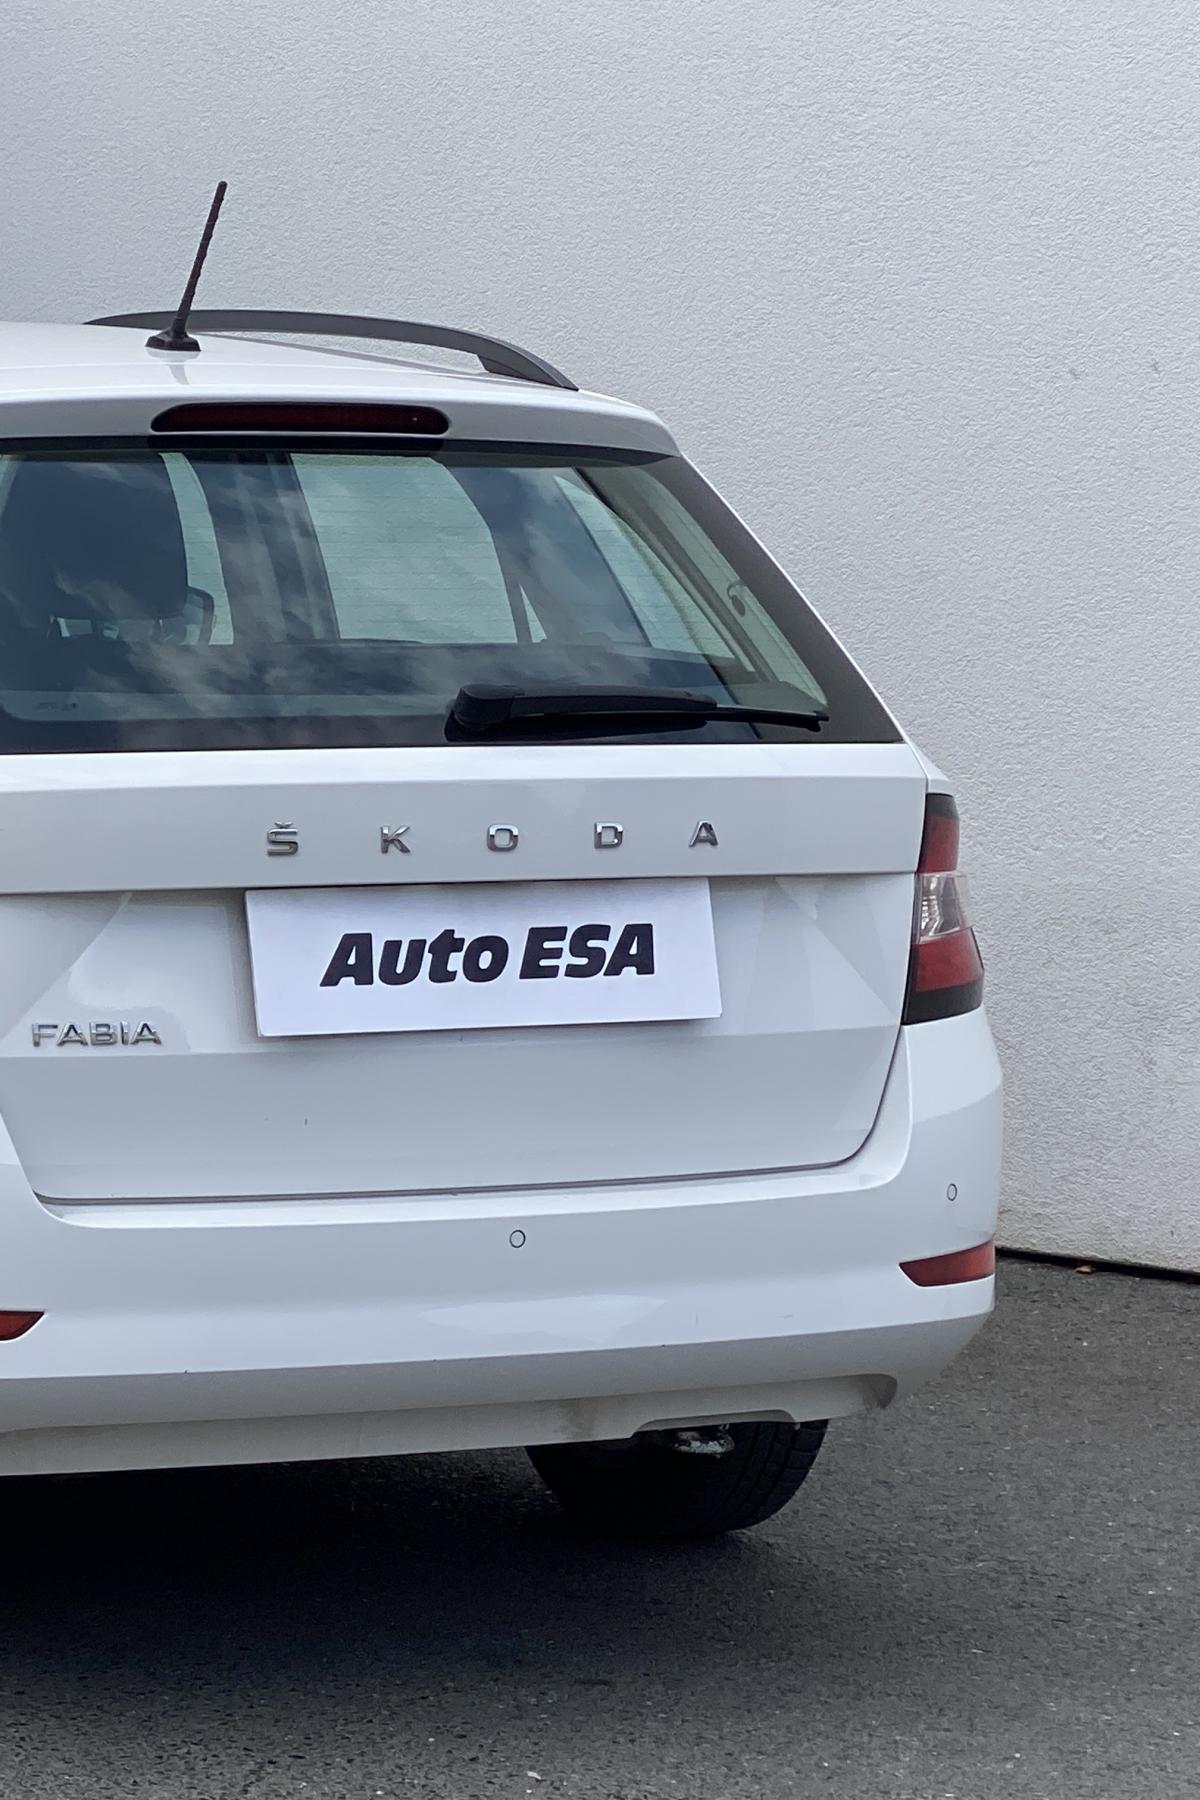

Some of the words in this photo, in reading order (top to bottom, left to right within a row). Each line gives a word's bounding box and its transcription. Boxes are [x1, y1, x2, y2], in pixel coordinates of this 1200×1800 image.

[266, 820, 720, 857] ŠKODA
[320, 928, 509, 988] Auto
[519, 923, 655, 981] ESA
[31, 1020, 162, 1047] FABIA
